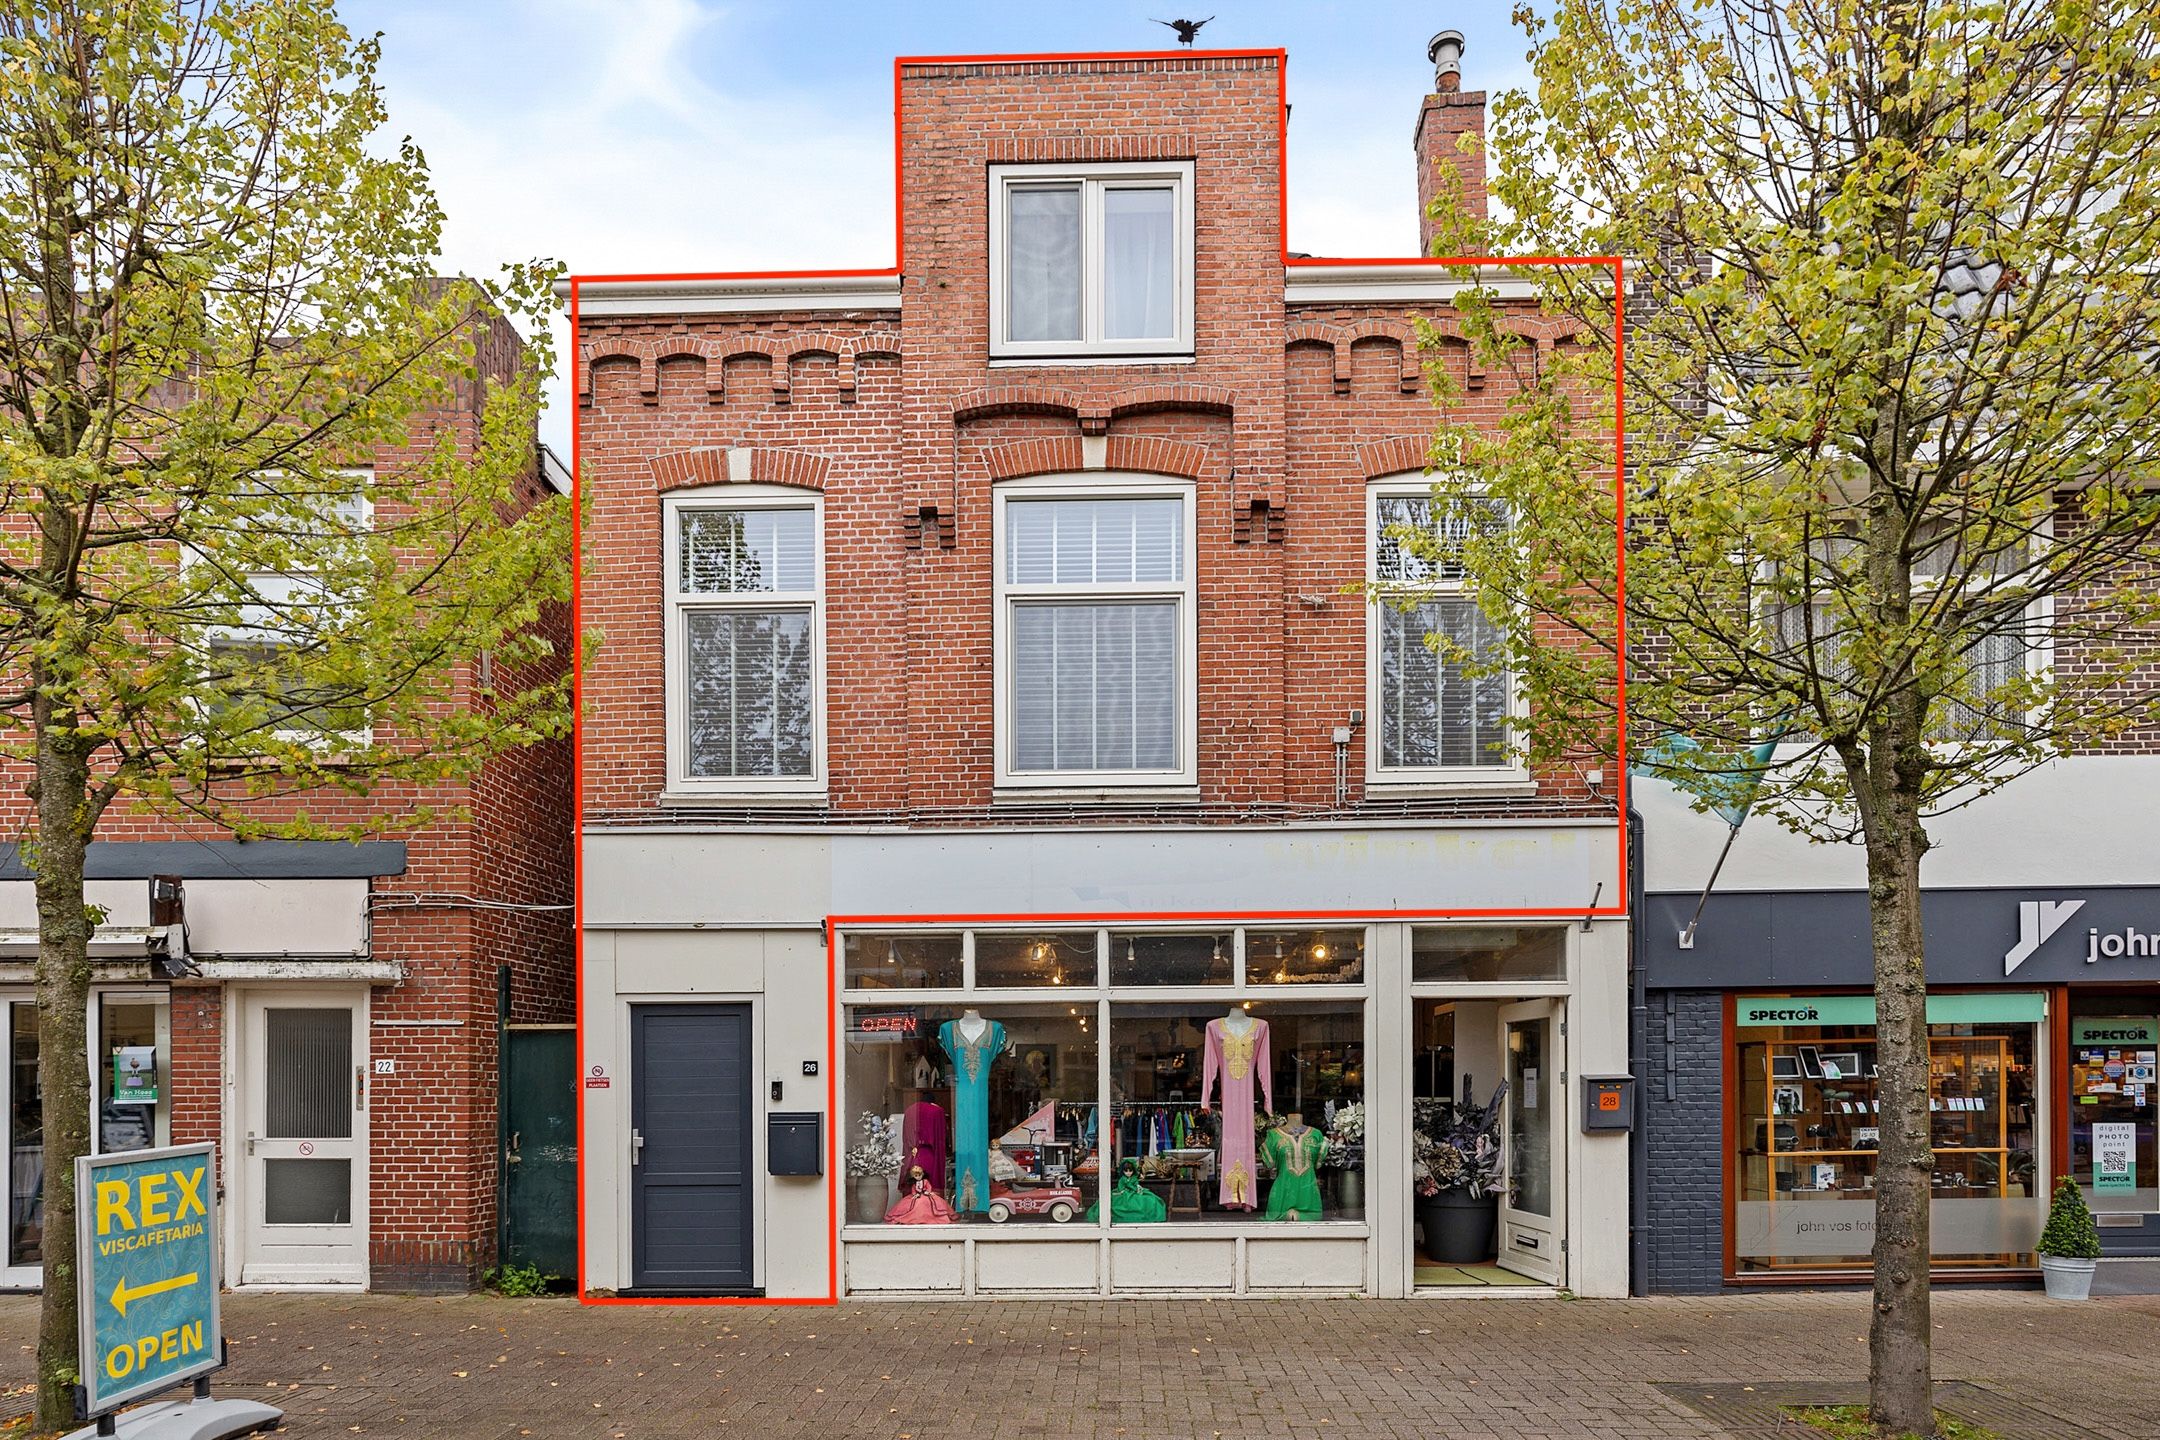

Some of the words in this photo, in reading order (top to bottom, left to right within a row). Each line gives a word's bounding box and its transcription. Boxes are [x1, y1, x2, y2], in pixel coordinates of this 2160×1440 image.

[1749, 1009, 1819, 1021] SPECTOR
[861, 1017, 917, 1032] OPEN
[2083, 1029, 2148, 1041] SPECTOR
[378, 1061, 391, 1072] 22
[804, 1063, 816, 1072] 26
[1602, 1096, 1617, 1106] 28
[96, 1167, 207, 1236] REX
[1796, 1220, 1826, 1234] john
[1829, 1223, 1852, 1232] vos
[99, 1222, 204, 1257] VISCAFETARIA
[106, 1320, 204, 1379] OPEN
